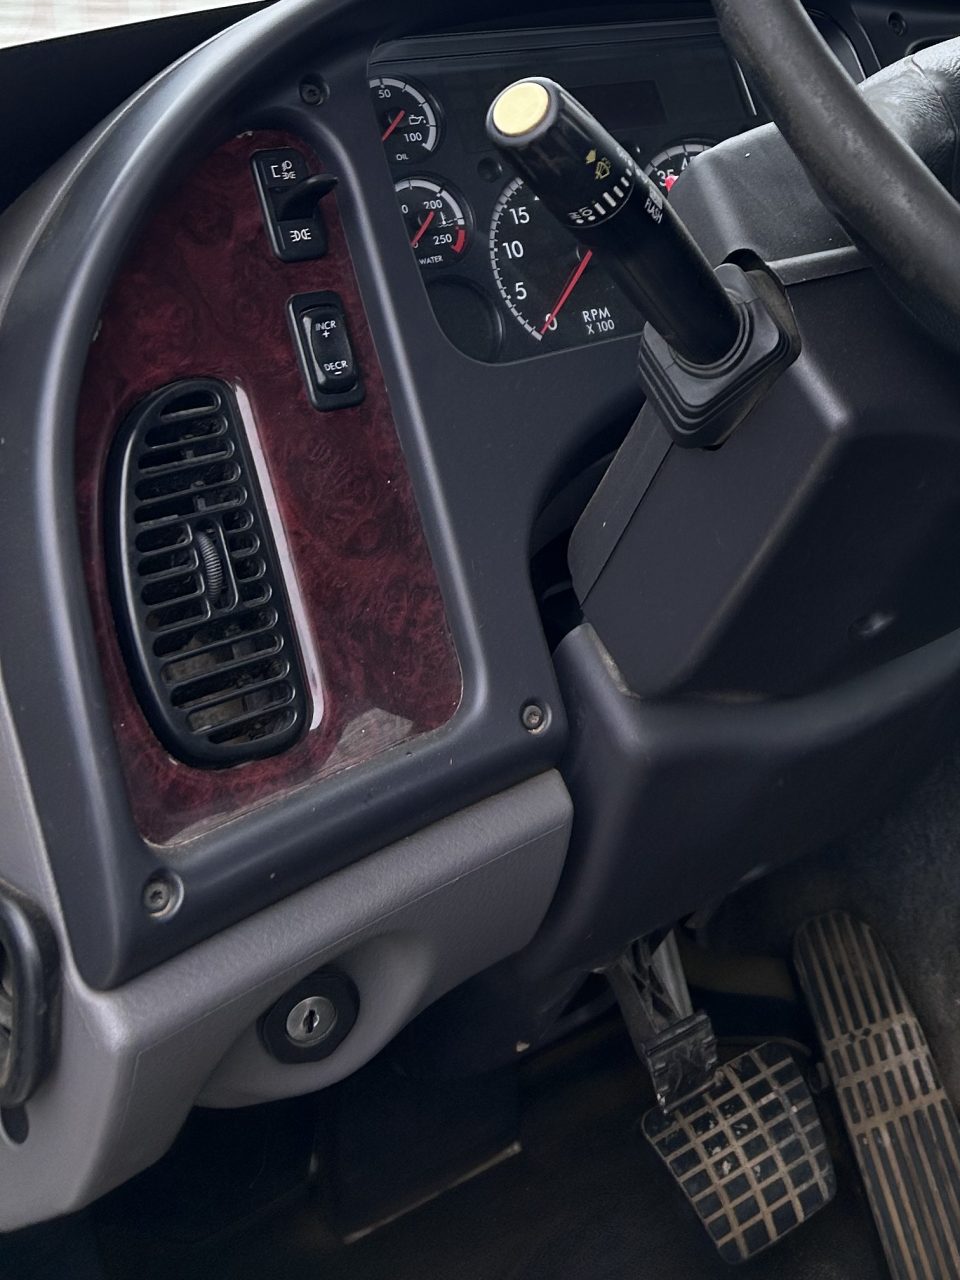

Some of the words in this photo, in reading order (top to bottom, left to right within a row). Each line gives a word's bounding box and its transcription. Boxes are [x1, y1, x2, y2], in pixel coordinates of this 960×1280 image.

[378, 89, 391, 98] 50
[404, 132, 422, 142] 100
[396, 153, 409, 161] OIL
[423, 200, 443, 210] 200
[645, 198, 663, 224] FLASH
[509, 206, 530, 225] 15
[432, 233, 453, 246] 250
[502, 240, 524, 259] 10
[418, 255, 444, 265] WATER
[515, 282, 527, 300] 5
[582, 307, 611, 322] RPM
[315, 320, 337, 330] INCR
[586, 324, 595, 335] X
[597, 319, 615, 332] 100
[324, 360, 349, 371] DECR
